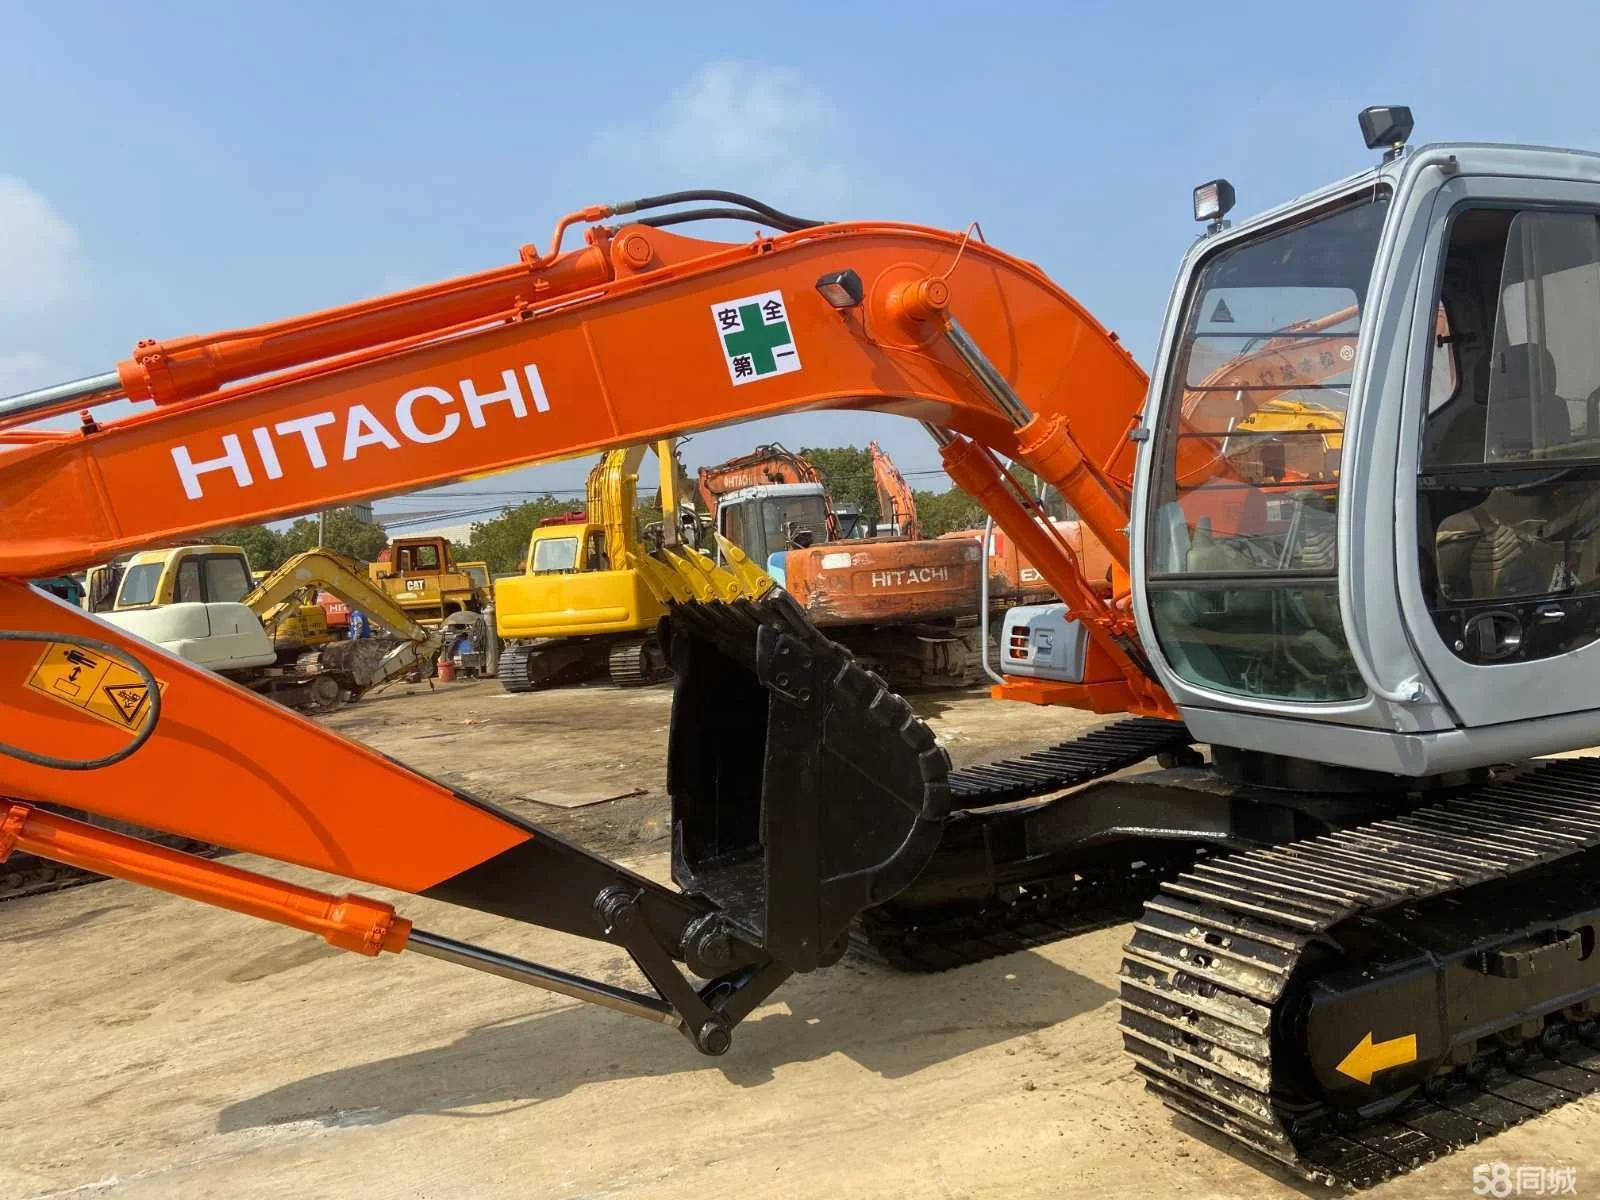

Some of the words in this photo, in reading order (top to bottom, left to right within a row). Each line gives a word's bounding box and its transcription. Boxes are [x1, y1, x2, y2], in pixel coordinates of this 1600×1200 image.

[718, 300, 784, 331] 安全
[733, 352, 795, 378] 第一
[171, 364, 550, 499] HITACHI
[407, 580, 424, 591] CAT
[871, 566, 949, 588] HITACHI
